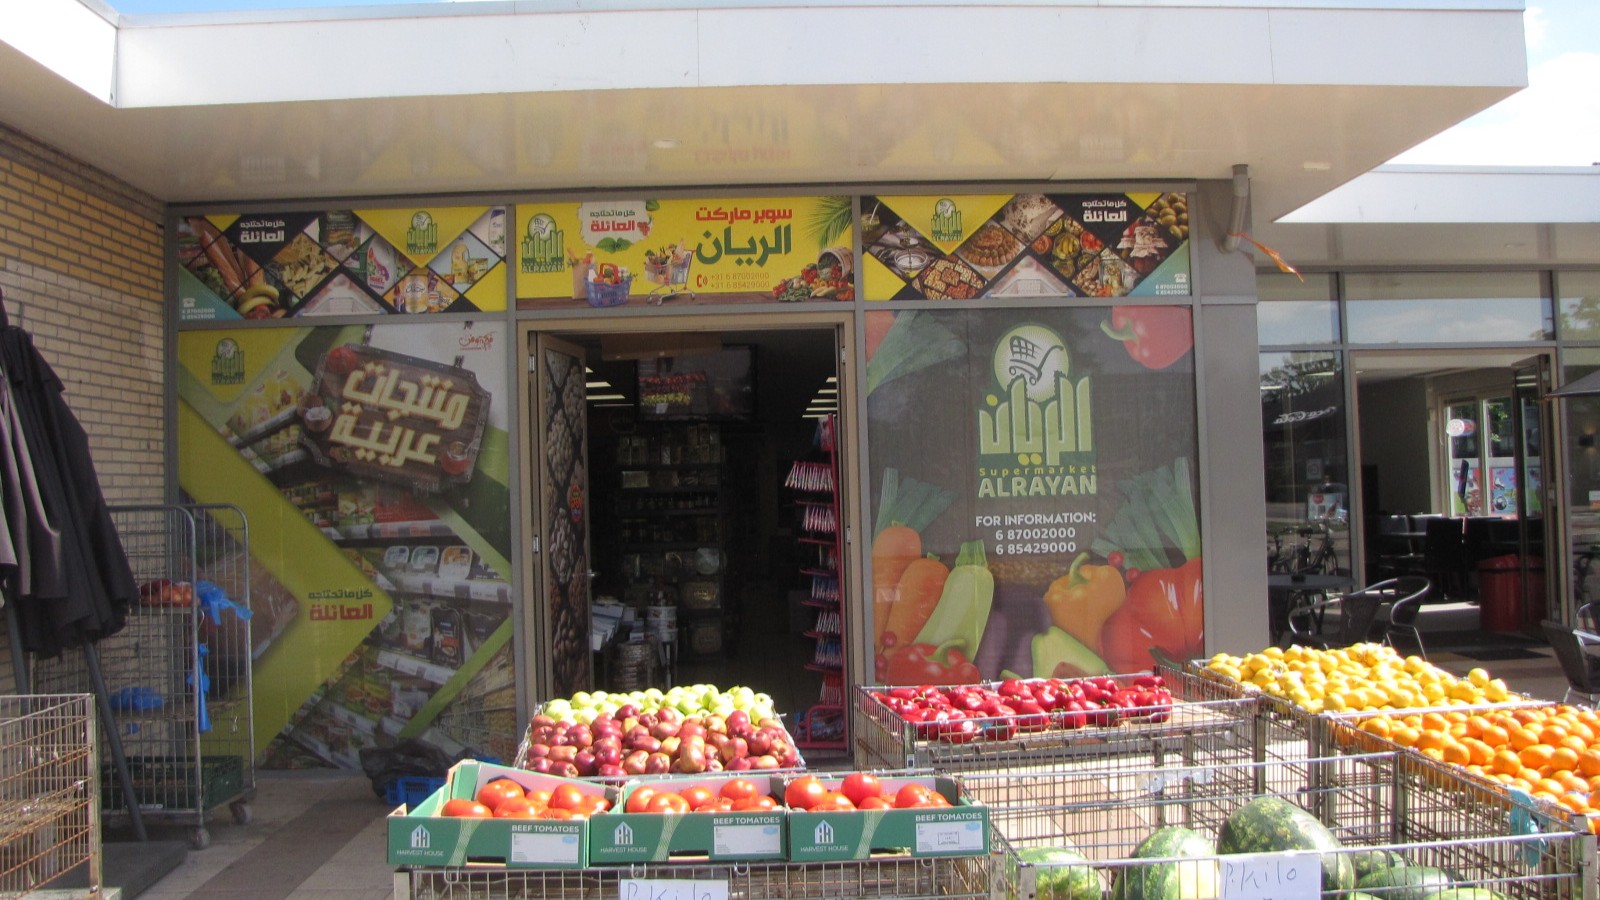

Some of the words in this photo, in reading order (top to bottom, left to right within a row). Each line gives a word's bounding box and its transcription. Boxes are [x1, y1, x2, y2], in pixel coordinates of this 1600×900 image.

[1114, 199, 1127, 208] كل
[615, 209, 623, 217] ما
[623, 209, 636, 218] كل
[695, 206, 752, 225] ماركت
[752, 208, 793, 224] سوبر
[1082, 209, 1127, 222] العائلة
[590, 219, 636, 232] العائلة
[240, 229, 285, 243] العائلة
[695, 223, 792, 268] الريان
[343, 361, 470, 430] منتجات
[329, 401, 442, 468] عربية
[979, 464, 1097, 477] Supermarket
[978, 474, 1097, 498] ALRAYAN
[975, 515, 1002, 527] FOR
[1004, 512, 1097, 526] INFORMATION:
[995, 529, 1004, 540] 6
[1007, 526, 1076, 540] 87002000
[995, 543, 1004, 555] 6
[1007, 541, 1077, 555] 85429000
[344, 589, 356, 599] ما
[356, 588, 373, 600] كل
[309, 603, 373, 621] العائلة
[713, 817, 734, 825] BEEF
[735, 816, 780, 825] TOMATOES
[915, 814, 937, 822] BEEF
[937, 812, 983, 821] TOMATOES
[511, 824, 533, 832] BEEF
[533, 824, 580, 833] TOMATOES
[396, 848, 423, 856] HARVEST
[425, 849, 444, 857] HOUSE
[600, 846, 626, 854] HARVEST
[627, 846, 648, 854] HOUSE
[800, 845, 827, 853] HARVEST
[828, 844, 849, 852] HOUSE
